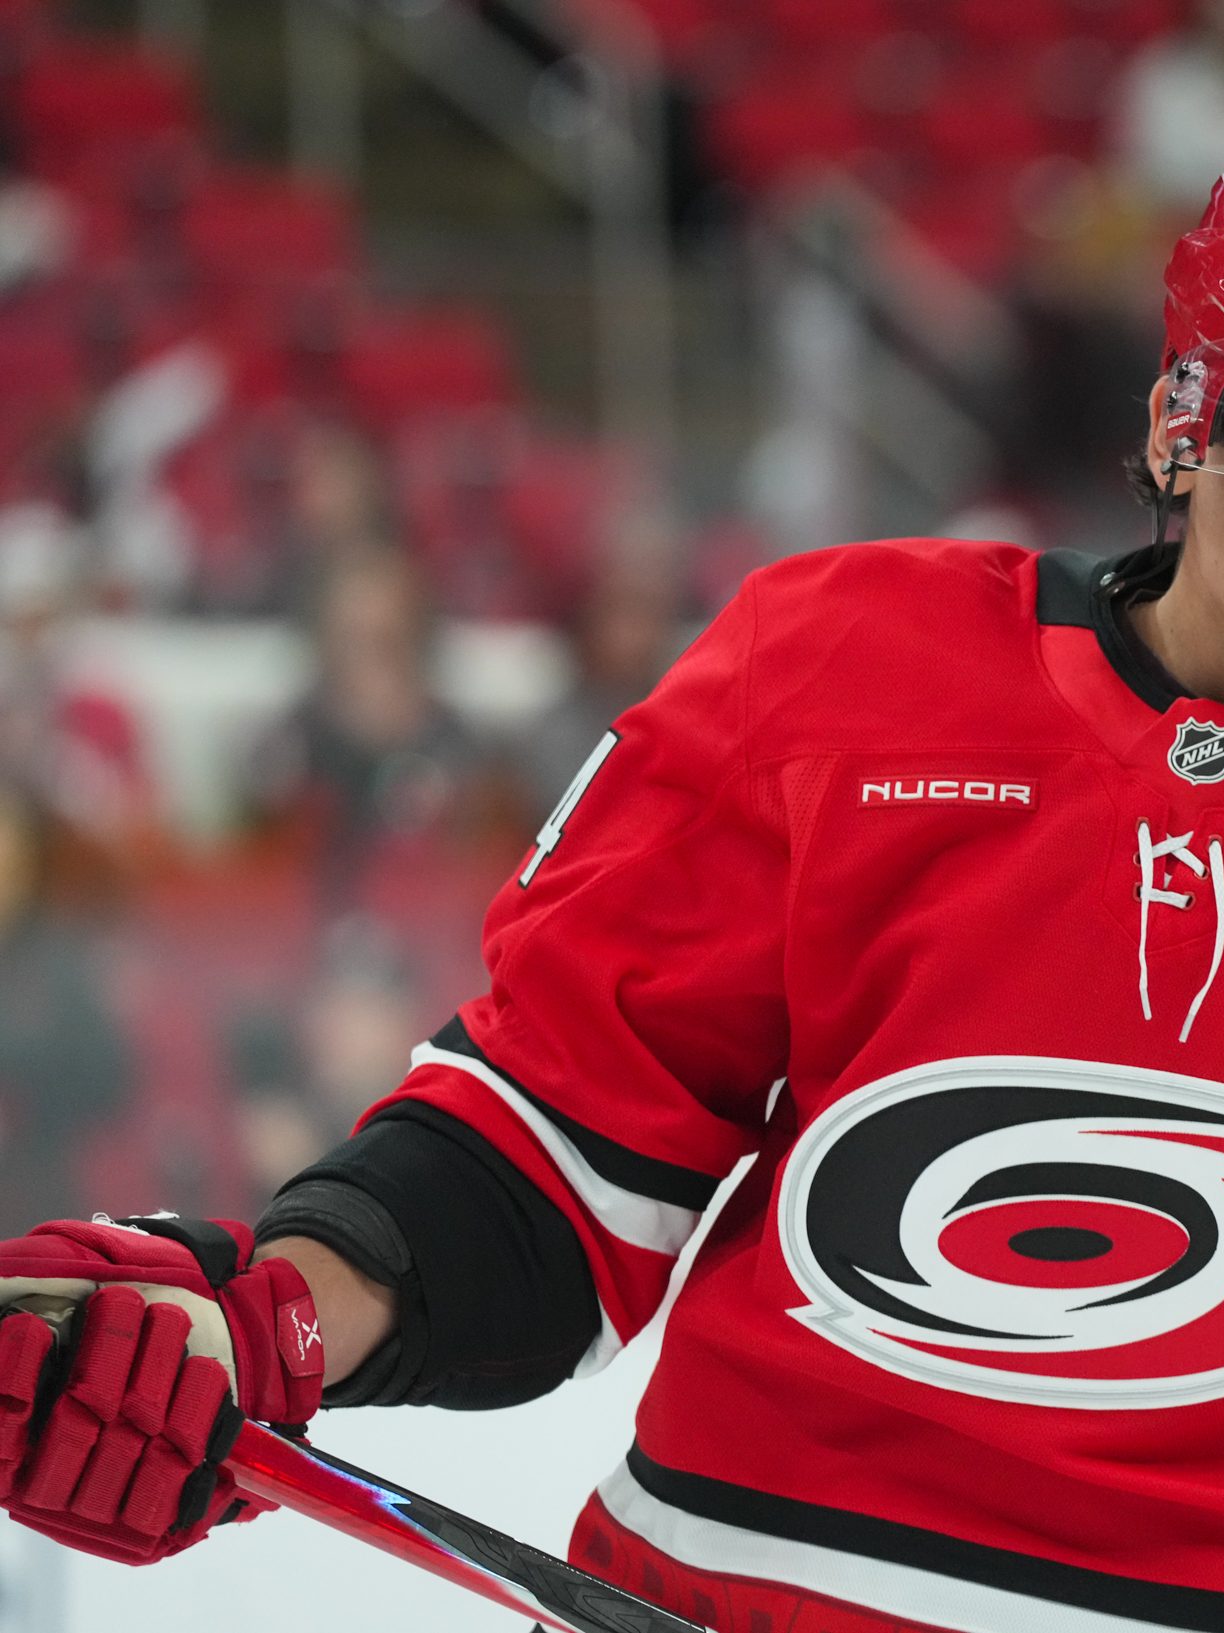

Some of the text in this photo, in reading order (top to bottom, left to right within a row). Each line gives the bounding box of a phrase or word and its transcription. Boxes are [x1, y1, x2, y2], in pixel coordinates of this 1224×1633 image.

[1181, 740, 1224, 767] NHL
[861, 780, 1031, 804] NUCOR
[518, 727, 623, 890] 4
